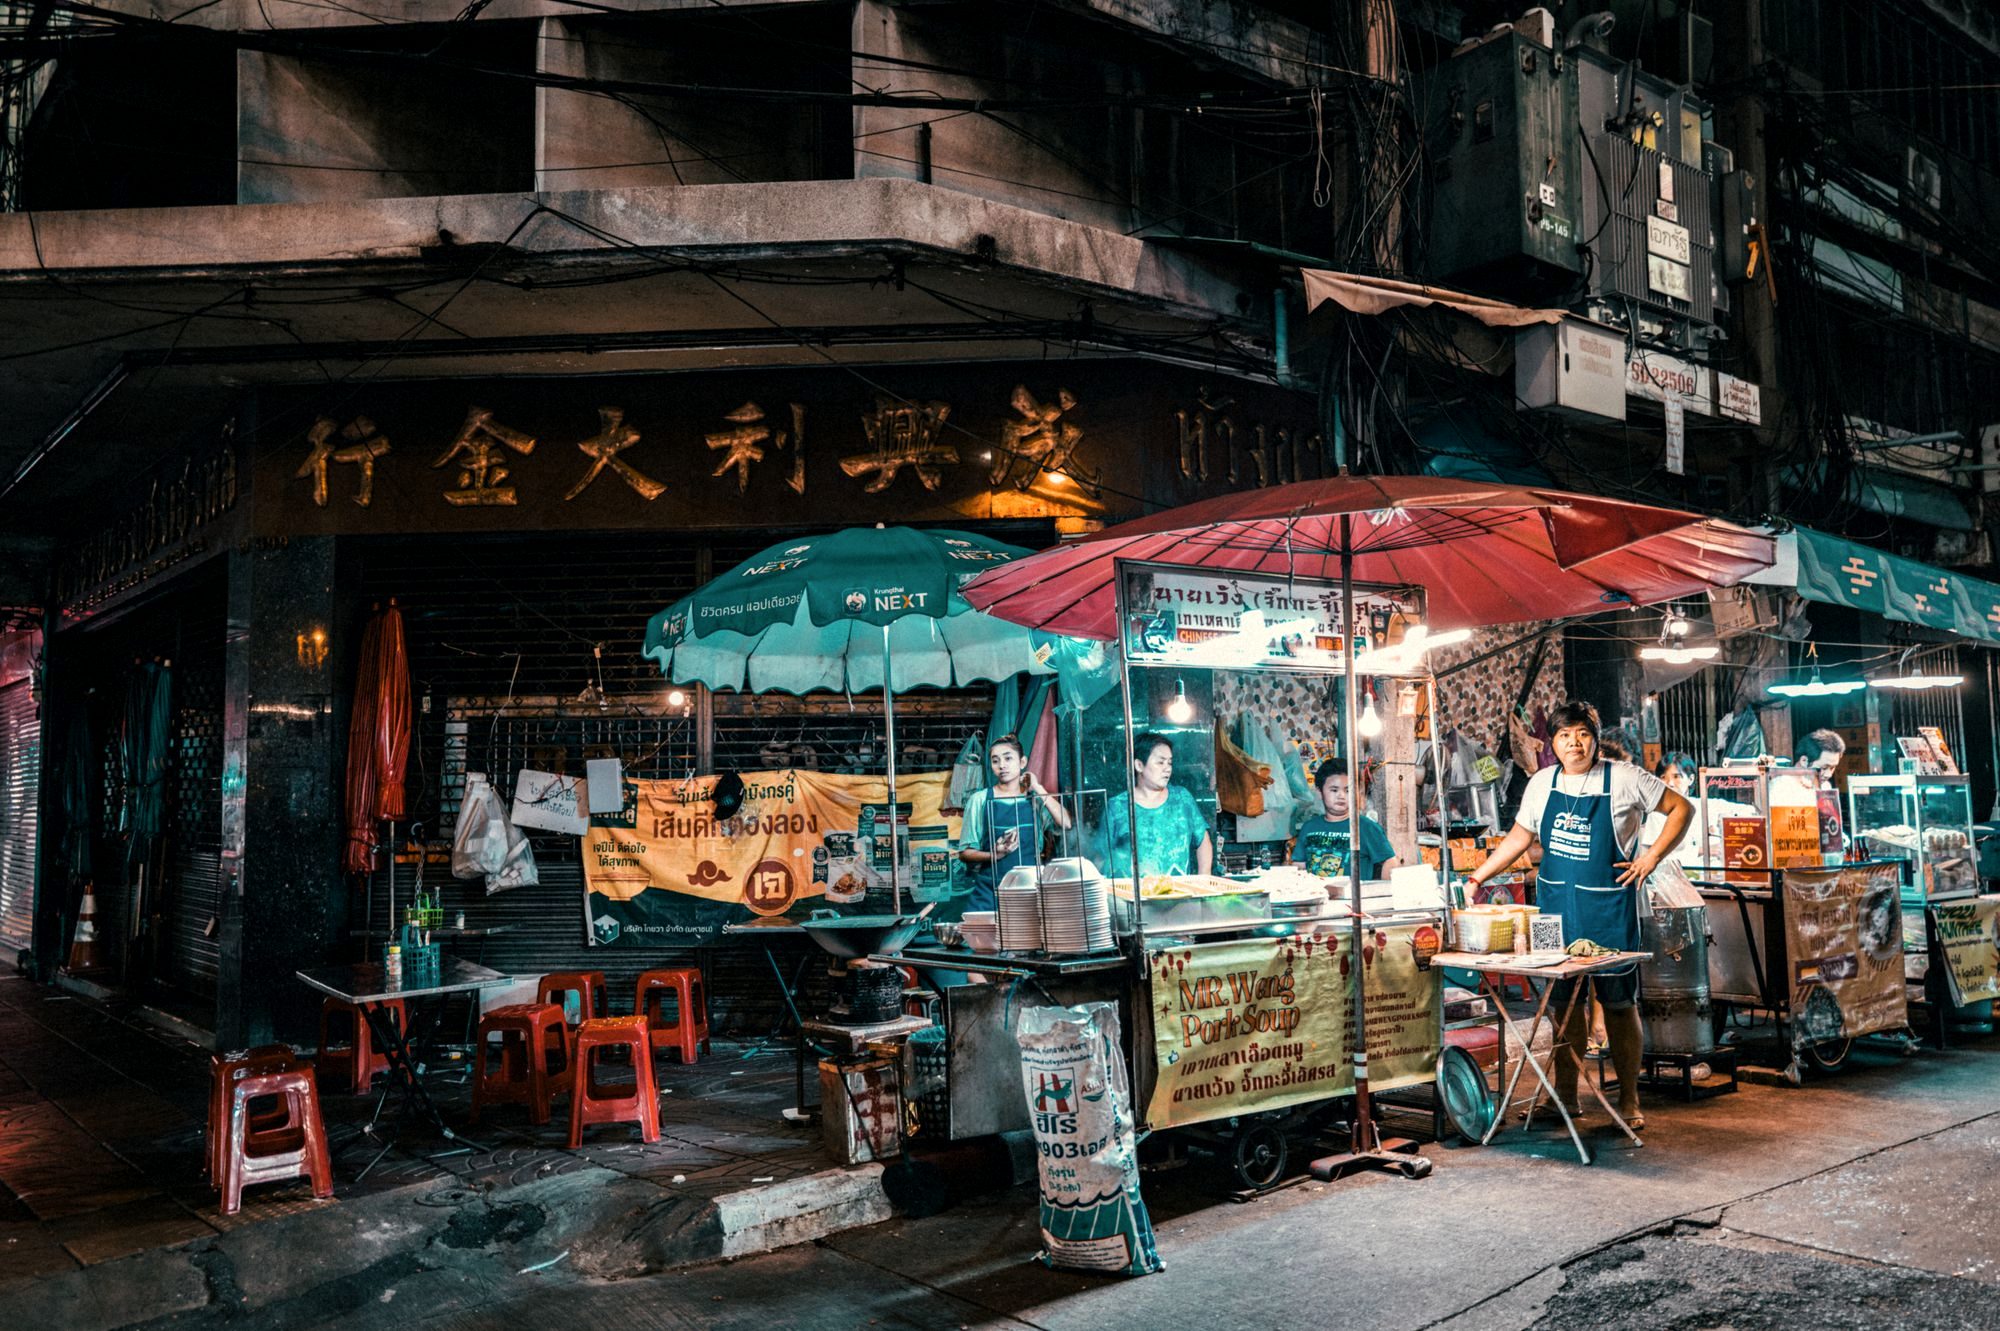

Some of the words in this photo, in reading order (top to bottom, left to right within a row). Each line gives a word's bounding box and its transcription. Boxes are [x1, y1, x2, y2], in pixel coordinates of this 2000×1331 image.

[1630, 360, 1649, 385] SD
[1651, 369, 1695, 395] 22506
[948, 551, 1012, 561] NEXT
[742, 558, 808, 577] NEXT
[874, 586, 905, 595] Krungthai
[1155, 584, 1243, 606] นายเว้ง
[874, 592, 928, 612] NEXT
[701, 604, 744, 618] ชีวิตครบ
[593, 838, 614, 853] เจปีนี้
[617, 841, 647, 854] ดีต่อใจ
[597, 854, 640, 870] ได้สุขภาพ
[623, 923, 643, 933] บริษัท
[644, 923, 664, 933] ไทยวา
[665, 923, 684, 933] จำกัด
[685, 924, 713, 935] (มหาชน)
[1181, 1008, 1241, 1048] Pork
[1240, 1003, 1301, 1038] Soup
[1181, 1042, 1304, 1077] เกาเหลาเลือดหมู
[1173, 1076, 1235, 1104] นายเว้ง
[1047, 1165, 1076, 1180] กุ้งรุ่น
